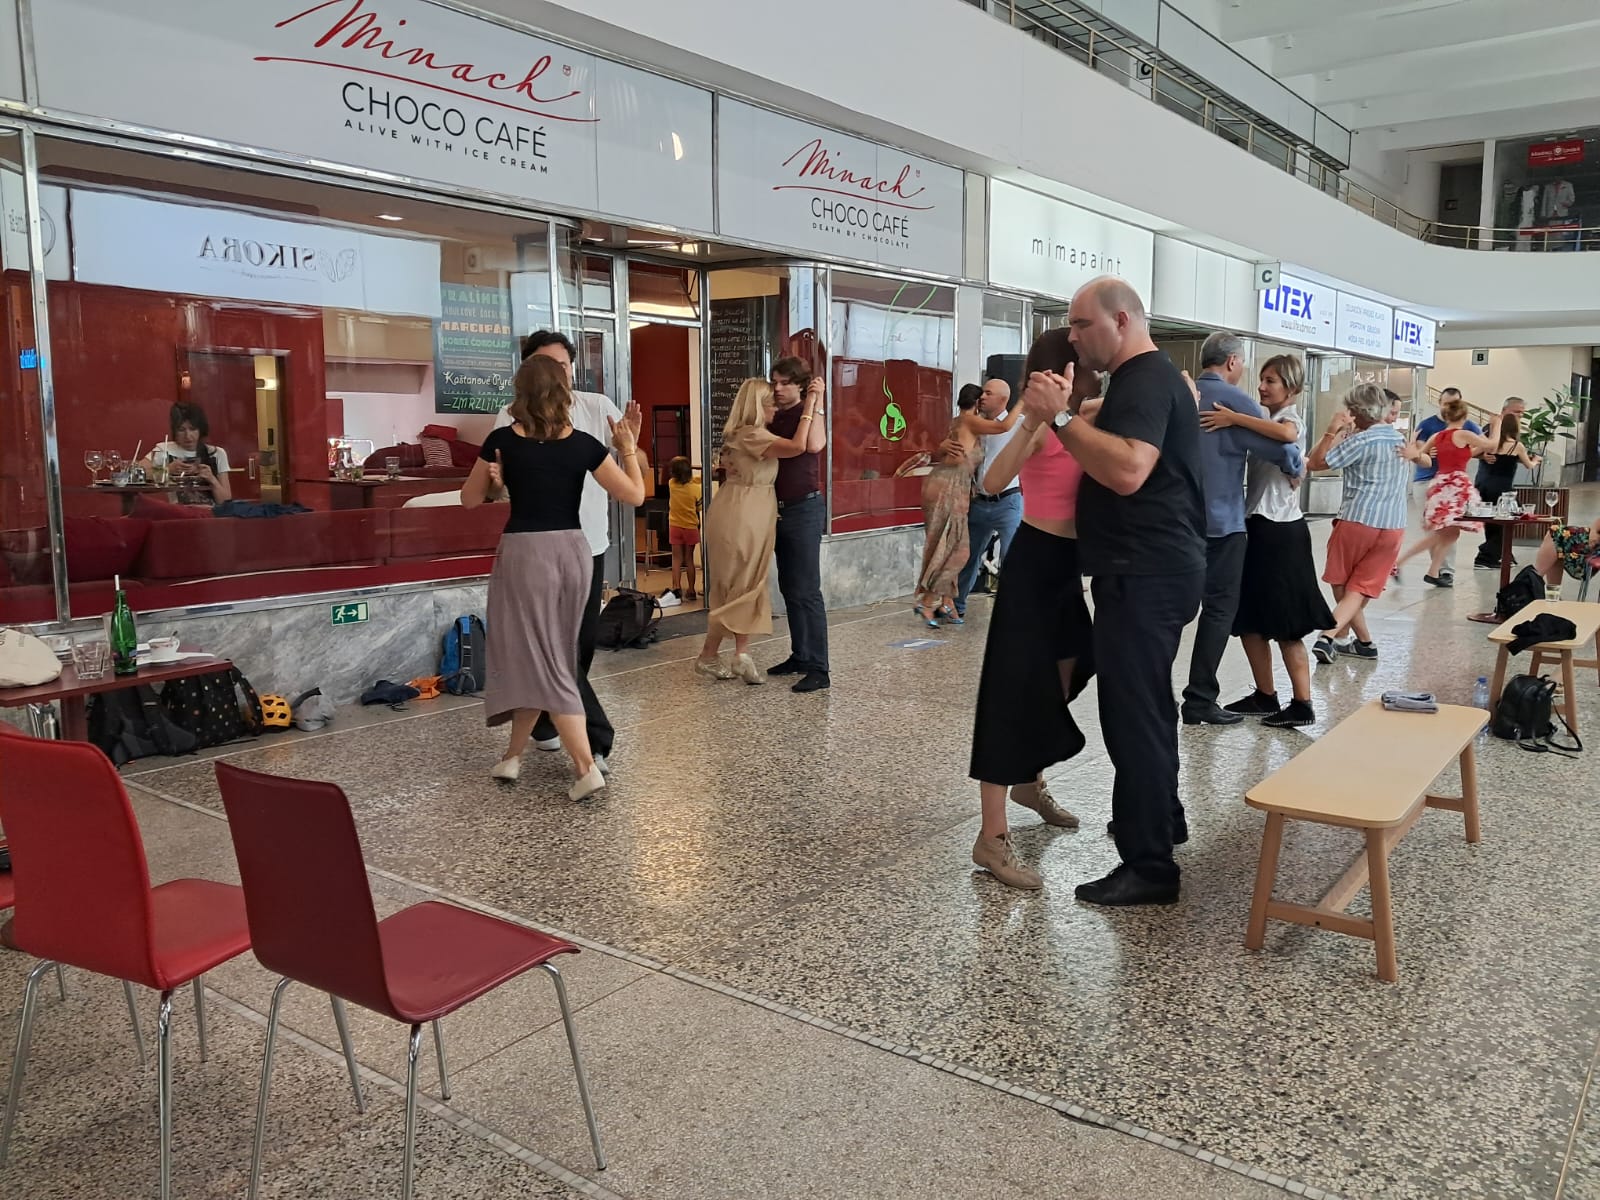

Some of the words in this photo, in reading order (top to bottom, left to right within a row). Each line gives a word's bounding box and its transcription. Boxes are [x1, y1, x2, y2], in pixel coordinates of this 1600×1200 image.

[274, 0, 580, 103] Minach
[1141, 62, 1152, 75] C
[342, 82, 466, 136] CHOCO
[475, 116, 547, 158] CAFÉ
[344, 119, 398, 139] ALIVE
[411, 134, 452, 151] WITH
[465, 147, 489, 160] ICE
[500, 155, 548, 174] CREAM
[782, 139, 925, 198] Minach
[811, 197, 869, 228] CHOCO
[872, 215, 909, 238] CAFÉ
[812, 222, 841, 234] DEATH
[846, 230, 856, 238] BY
[862, 233, 909, 249] CHOCOLATE
[1032, 237, 1121, 275] mimapaint
[1261, 269, 1273, 283] C
[1264, 284, 1313, 320] LITEX
[1395, 318, 1422, 346] LITEX
[1477, 353, 1484, 361] B
